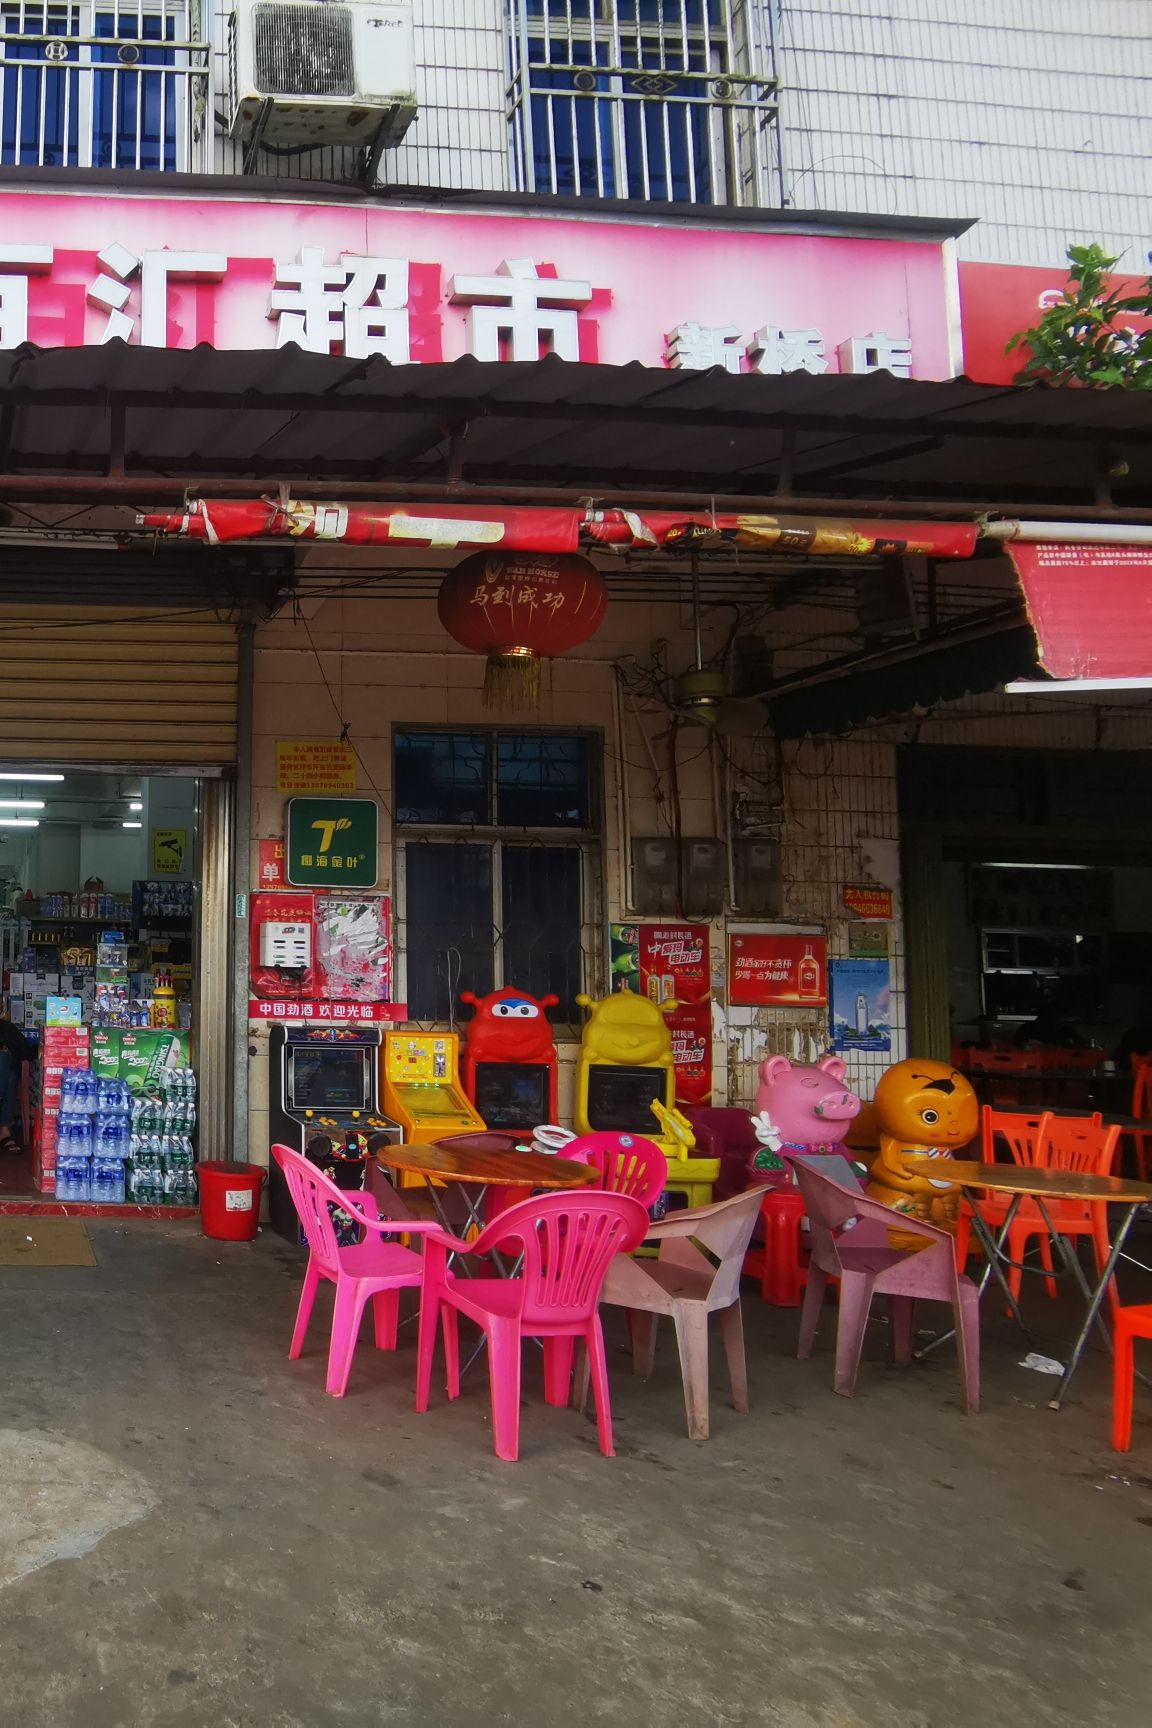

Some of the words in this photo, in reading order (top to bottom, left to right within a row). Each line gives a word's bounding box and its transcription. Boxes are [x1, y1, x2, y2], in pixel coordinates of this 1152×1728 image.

[470, 585, 565, 609] 马到成功
[260, 1003, 313, 1016] 中国劲酒
[319, 1004, 373, 1018] 欢迎光临
